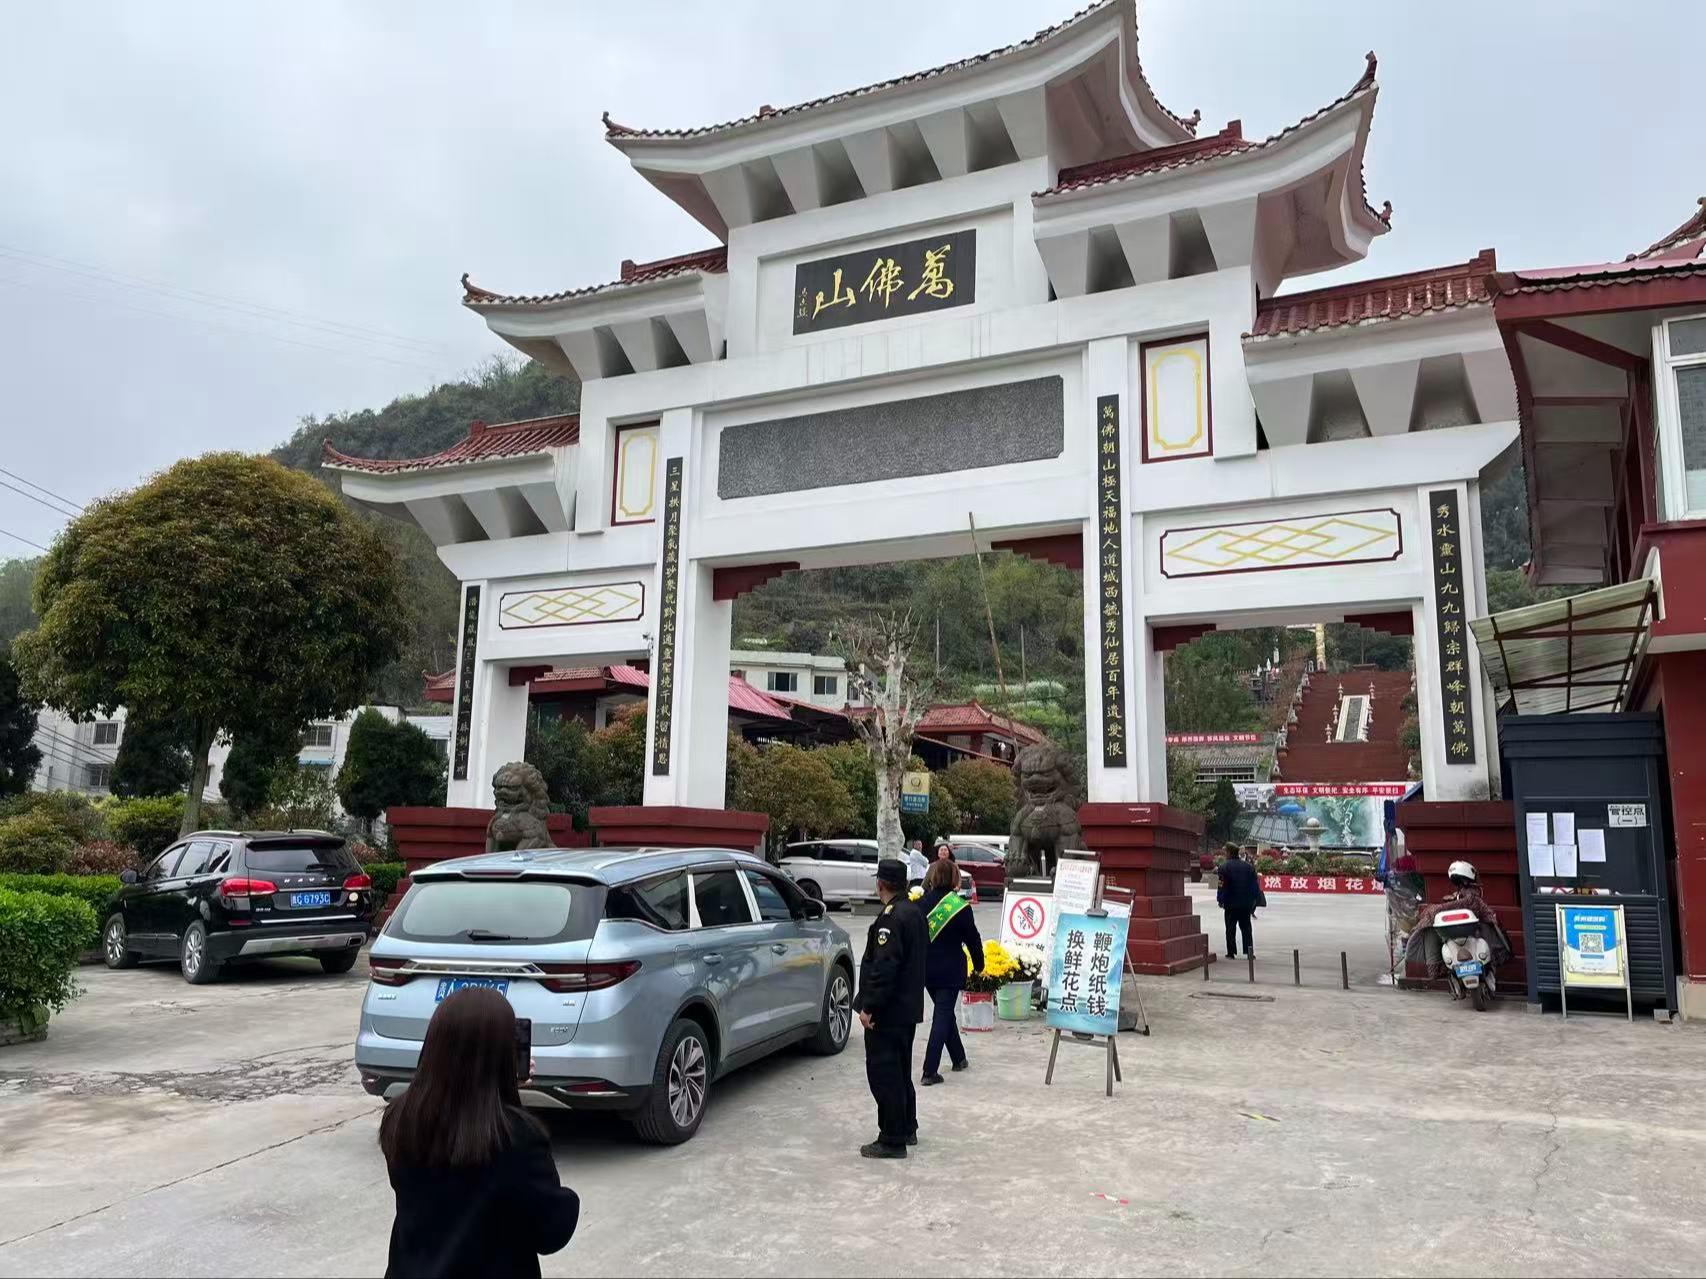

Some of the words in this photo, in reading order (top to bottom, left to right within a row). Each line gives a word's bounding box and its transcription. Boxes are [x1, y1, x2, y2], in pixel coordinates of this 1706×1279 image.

[811, 244, 954, 320] 萬佛山
[1060, 929, 1085, 1013] 换鲜花点
[1086, 931, 1113, 1017] 鞭炮纸钱
